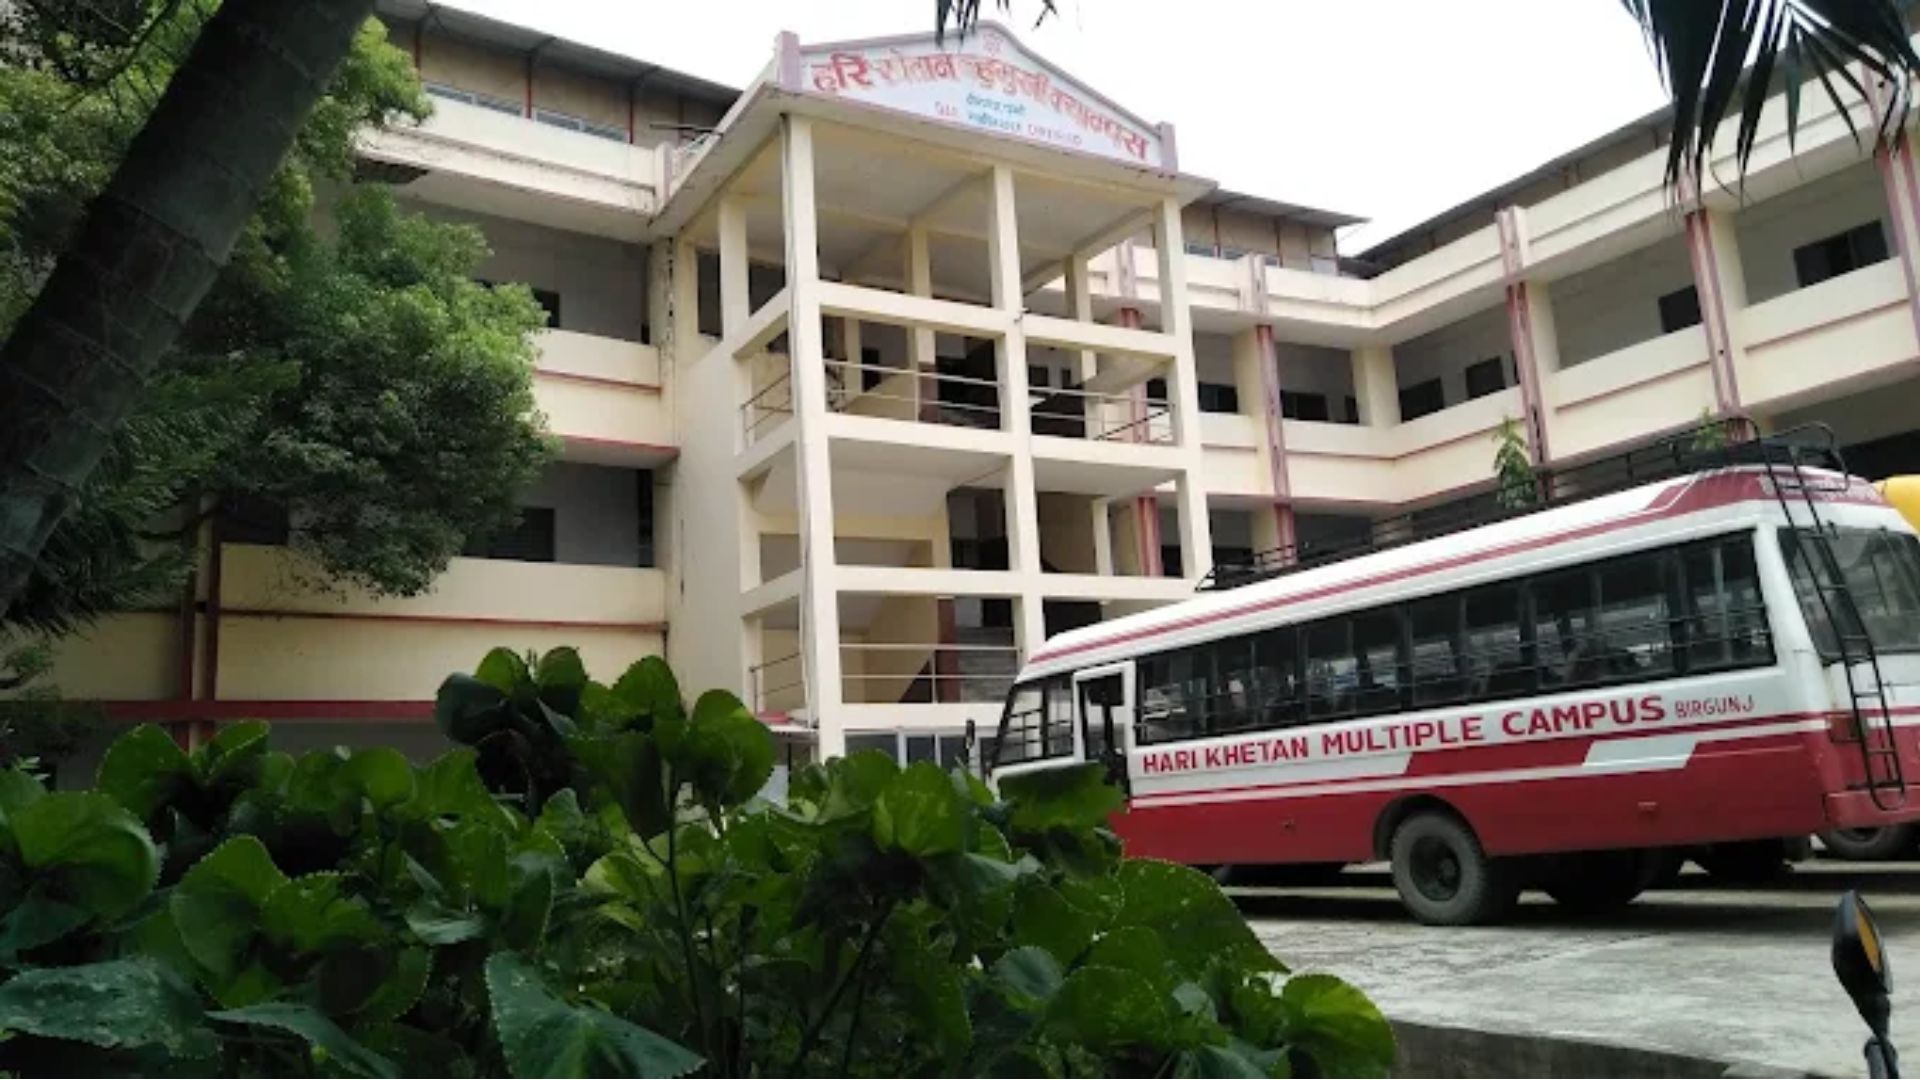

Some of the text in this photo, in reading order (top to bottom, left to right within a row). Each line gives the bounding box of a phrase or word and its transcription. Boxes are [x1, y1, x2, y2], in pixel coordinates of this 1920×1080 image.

[811, 52, 873, 92] हरि
[1143, 694, 1755, 774] HARI KHETAN MULTIPLE CAMPUS BIRGUNJ
